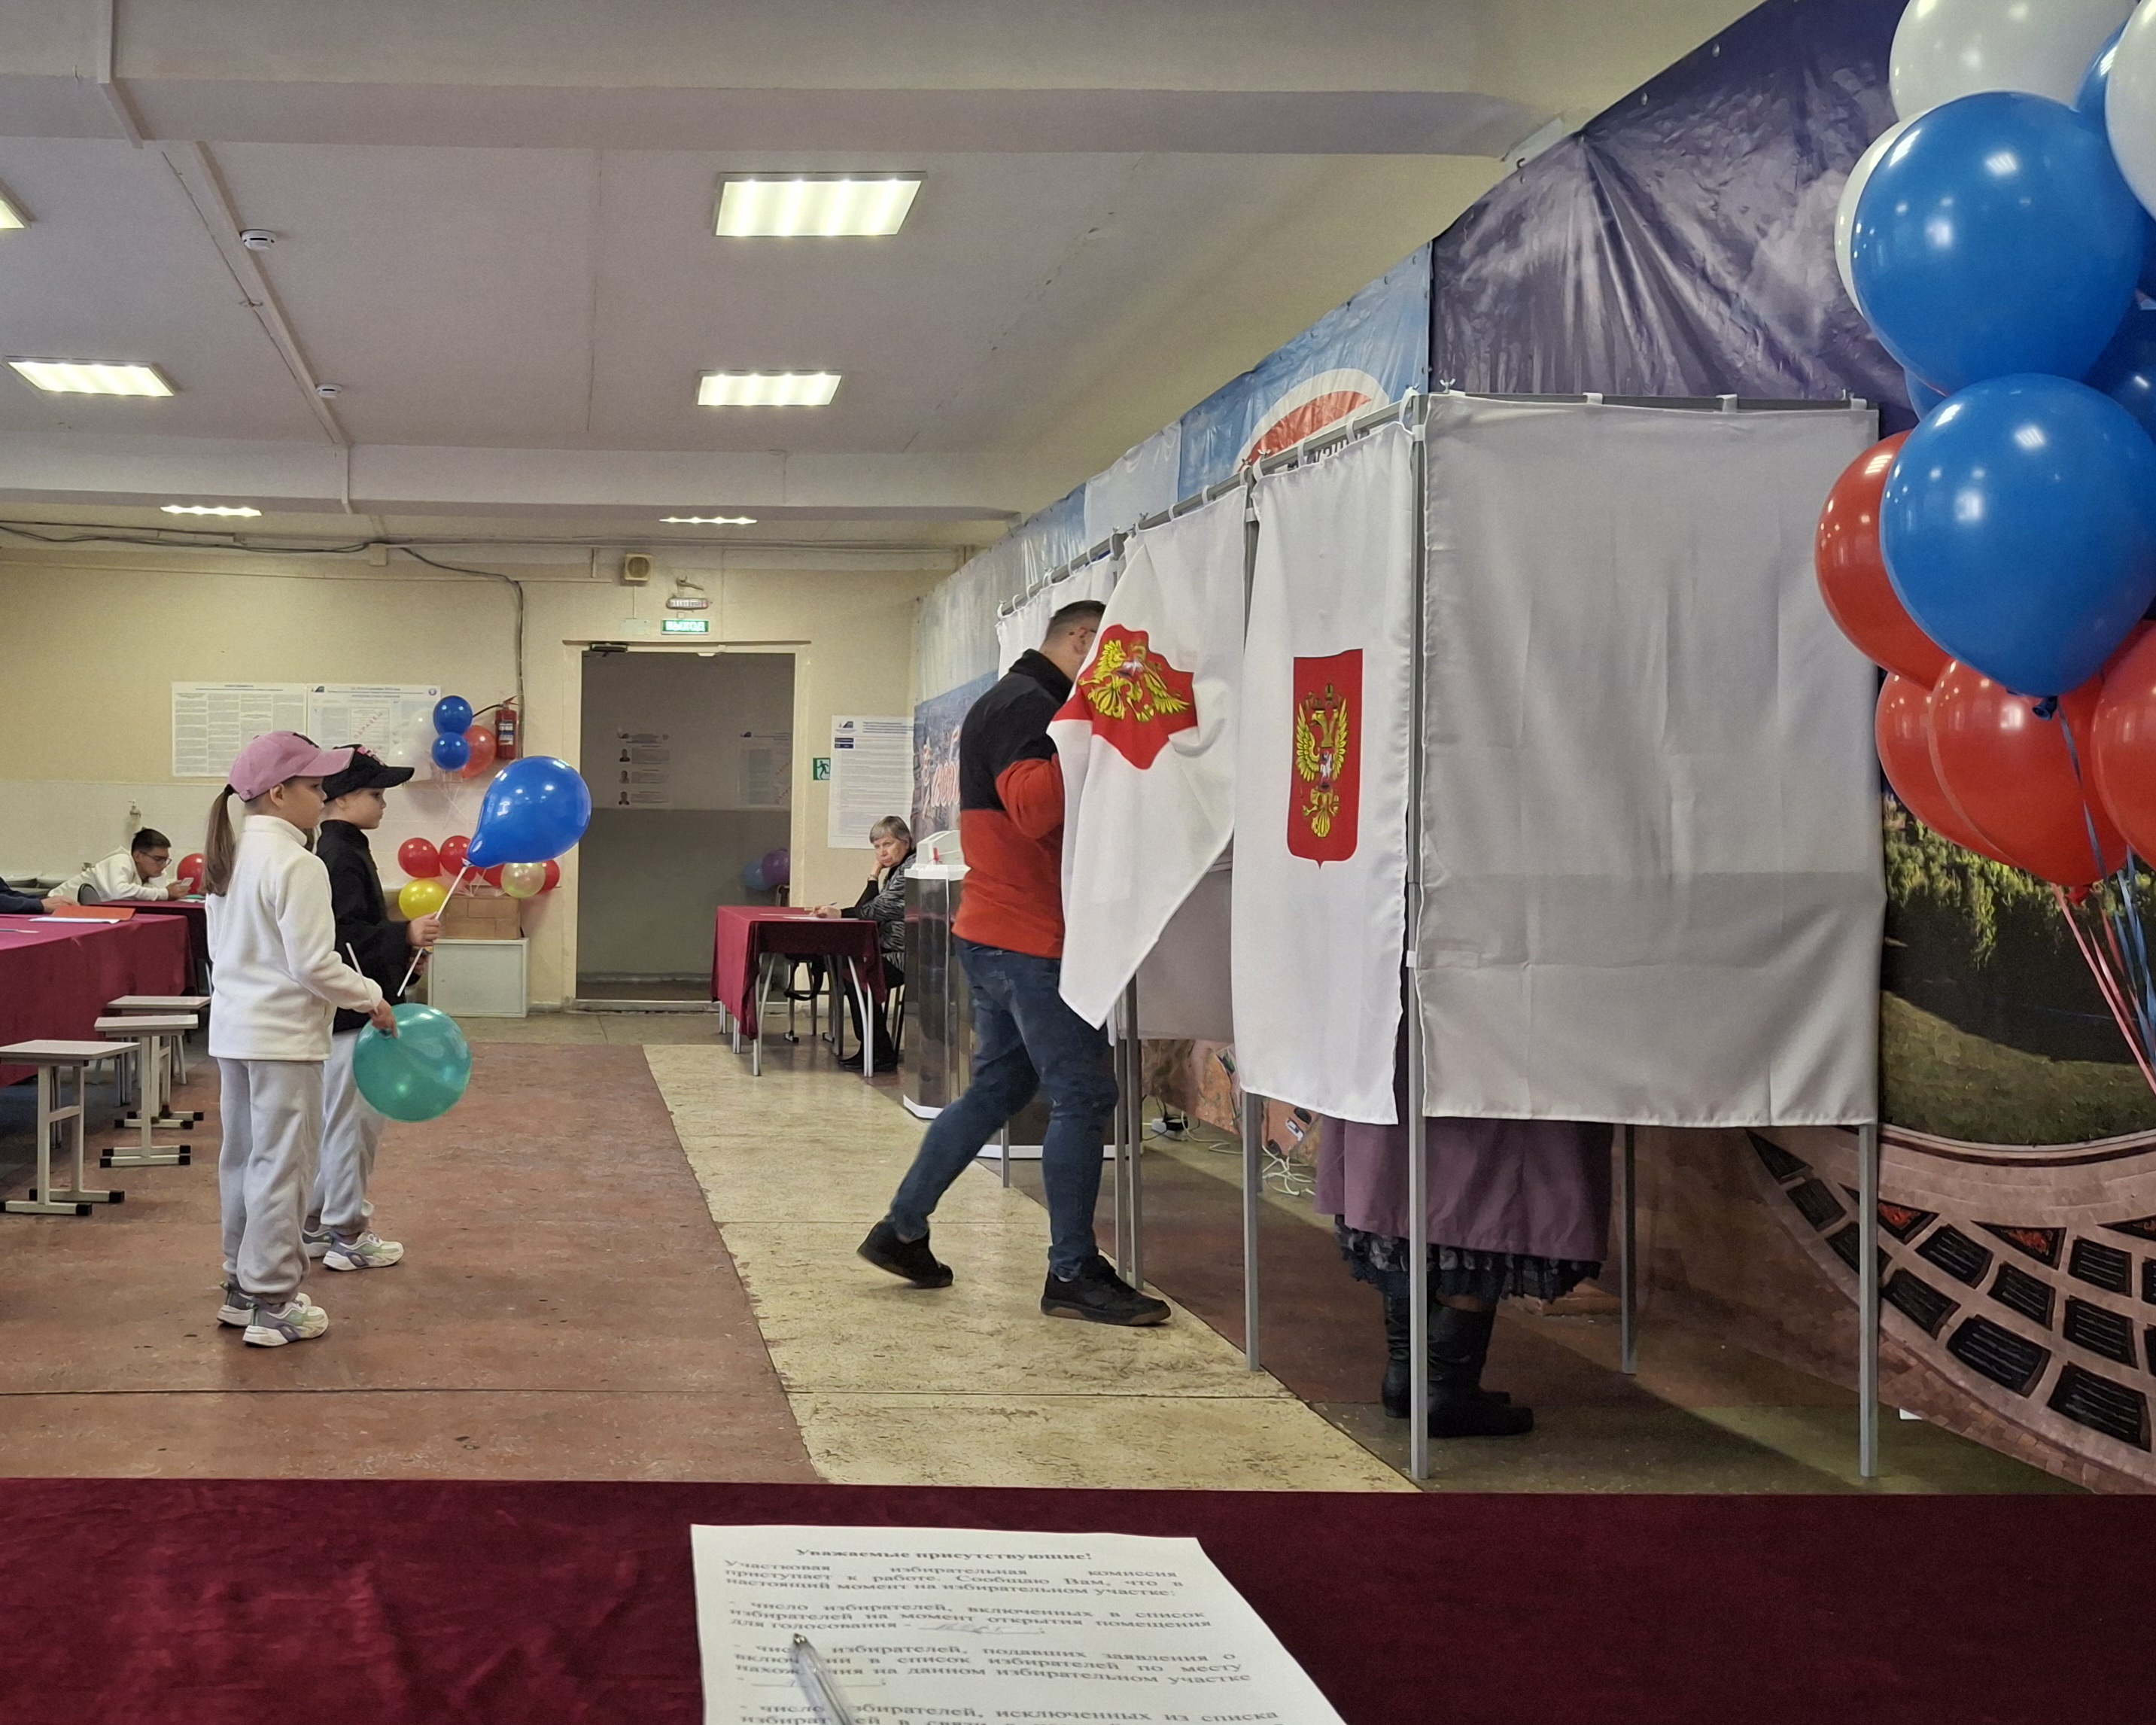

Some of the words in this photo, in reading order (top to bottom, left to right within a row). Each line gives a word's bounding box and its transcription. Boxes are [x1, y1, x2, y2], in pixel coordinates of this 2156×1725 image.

[665, 621, 706, 632] ВЫХОД
[795, 1549, 910, 1559] Уважаемые
[725, 1560, 830, 1571] Участковая
[890, 1566, 1027, 1575] избирательная
[725, 1570, 832, 1580] приступает
[874, 1574, 940, 1584] работе.
[956, 1576, 1050, 1585] Сообщаю
[1064, 1577, 1111, 1586] Вам,
[726, 1578, 829, 1590] настоящий
[944, 1584, 1088, 1593] избирательном
[730, 1610, 853, 1620] избирателей
[968, 1606, 1093, 1617] включенных
[731, 1619, 764, 1628] для
[832, 1645, 968, 1654] избирателей,
[983, 1648, 1087, 1657] подавших
[1102, 1653, 1209, 1662] заявления
[734, 1654, 851, 1664] включии
[989, 1657, 1119, 1670] избирателей
[1181, 1664, 1242, 1672] месту
[734, 1665, 863, 1675] нахожния
[997, 1669, 1159, 1682] избирательном
[1169, 1675, 1251, 1684] участке
[741, 1716, 880, 1725] избиратей
[846, 1704, 984, 1717] збирателей,
[996, 1711, 1152, 1720] исключенных
[1165, 1714, 1189, 1722] из
[1200, 1712, 1279, 1722] списка
